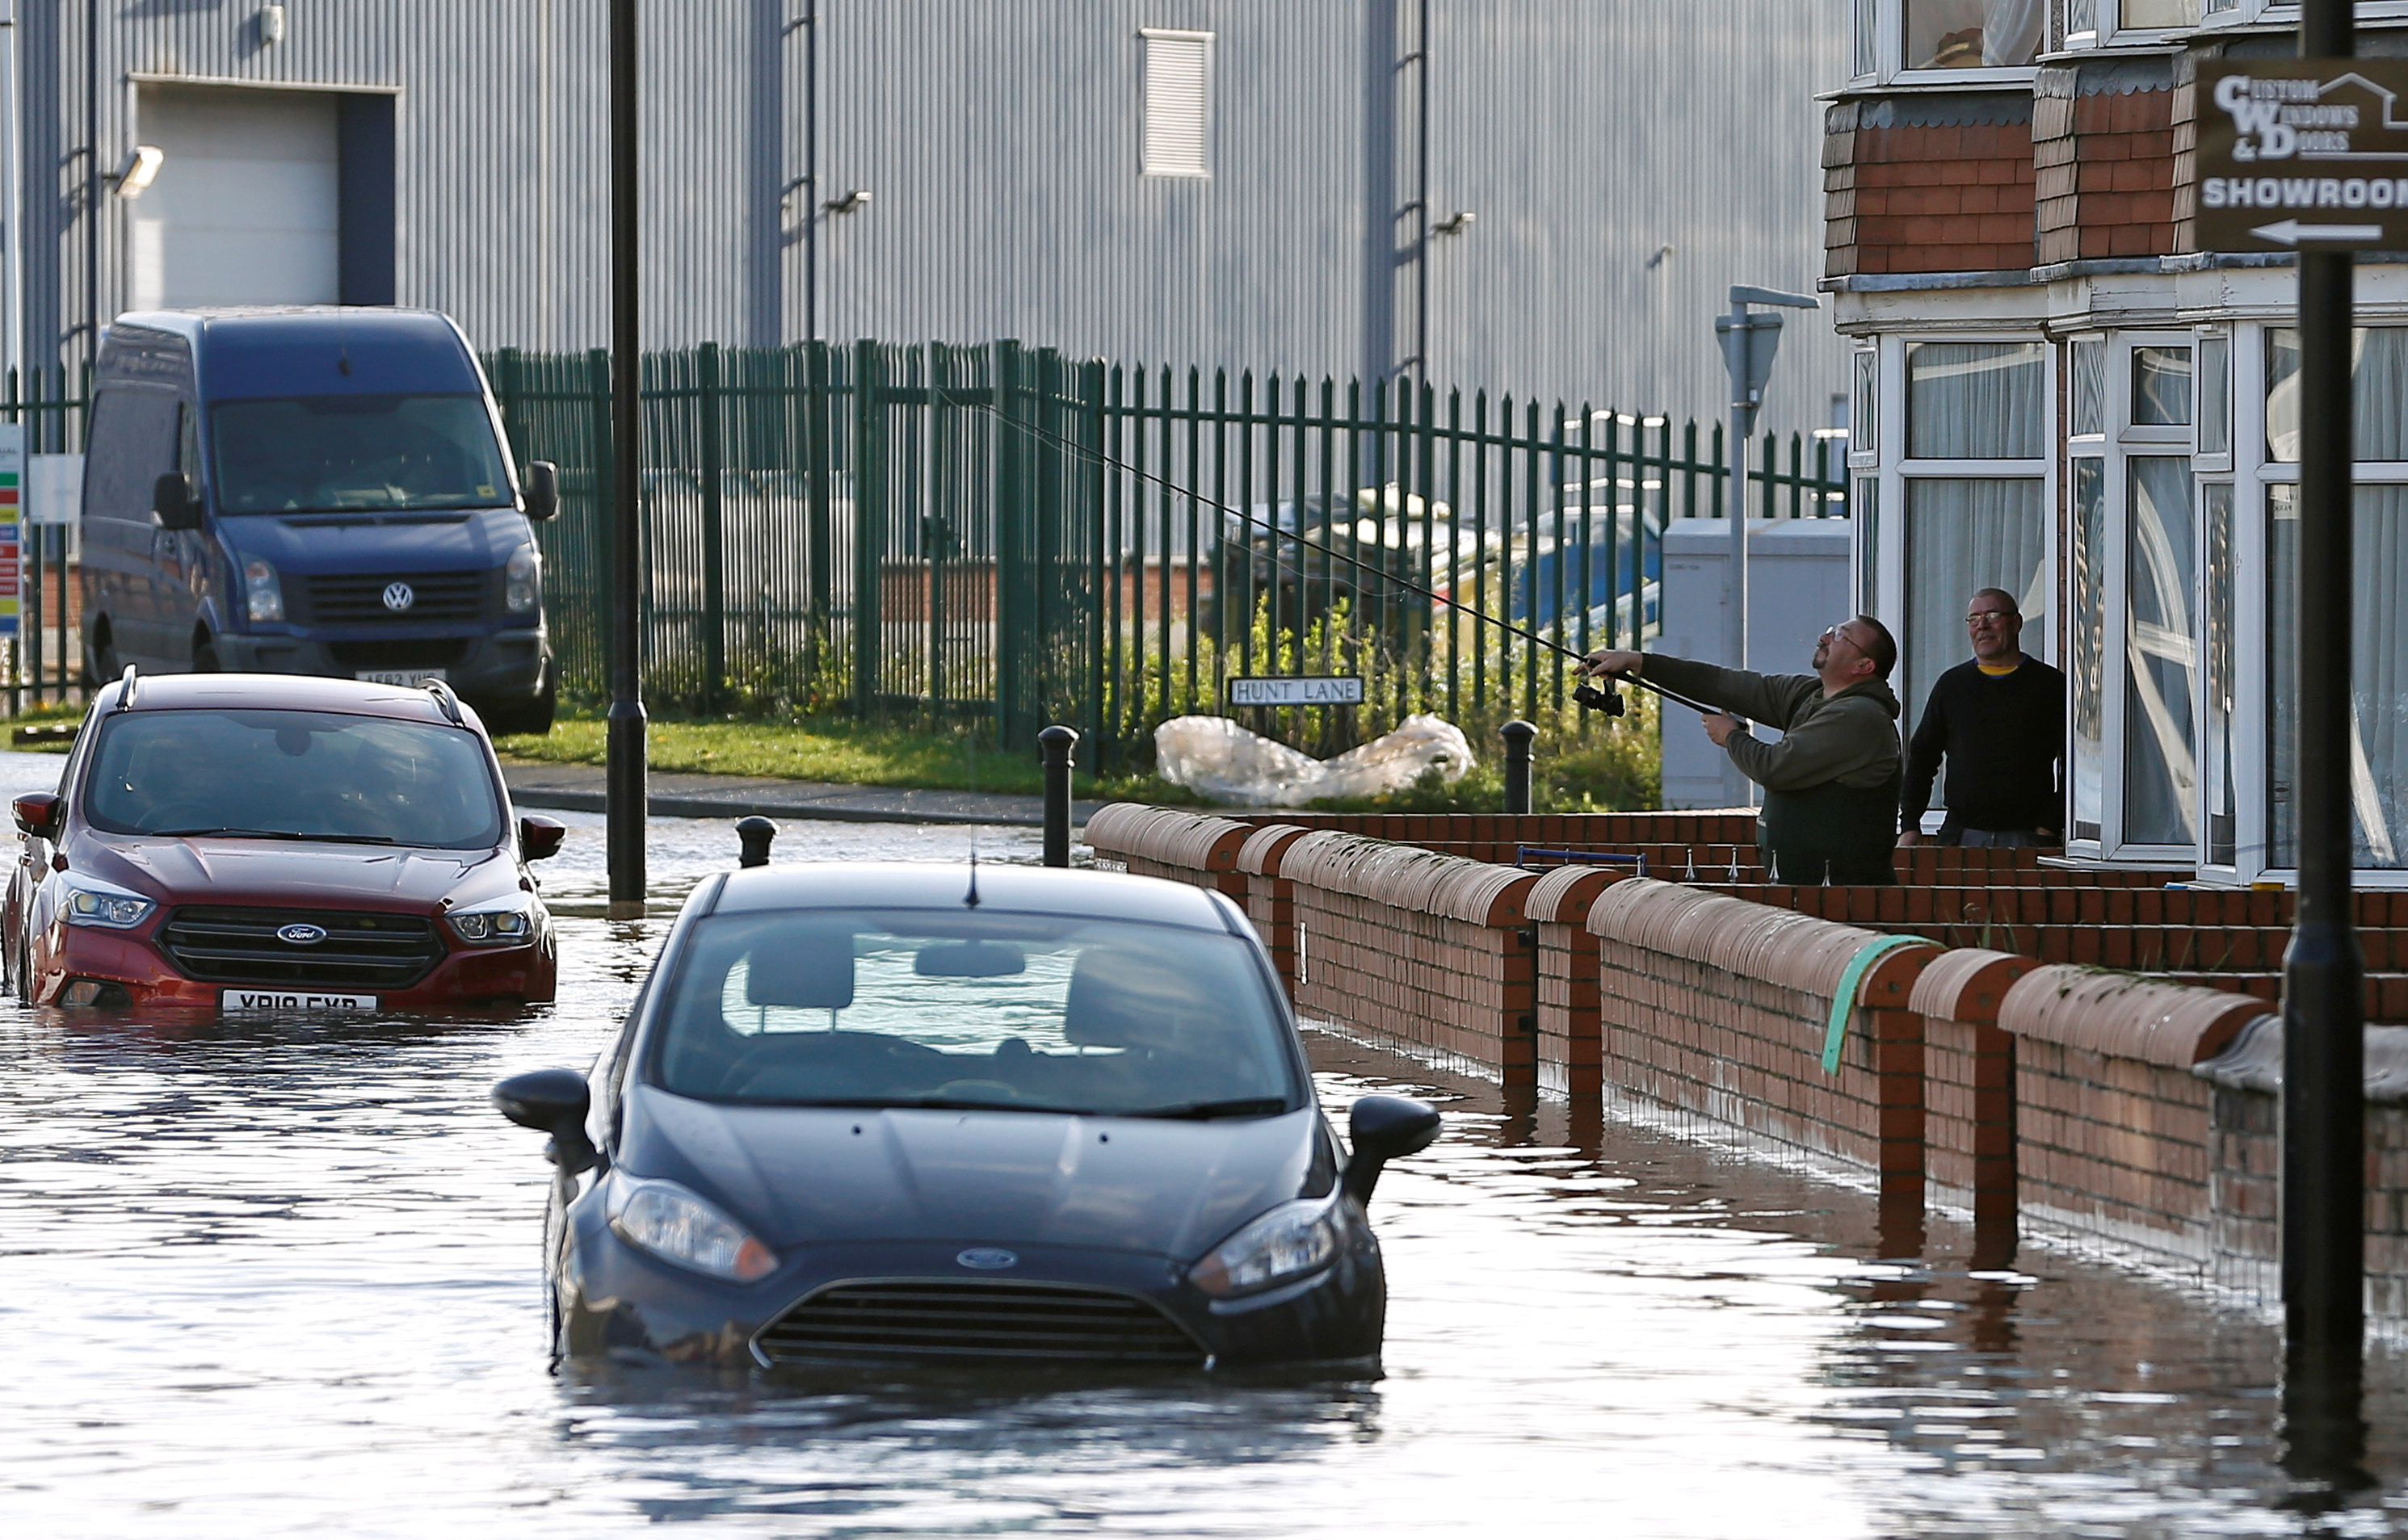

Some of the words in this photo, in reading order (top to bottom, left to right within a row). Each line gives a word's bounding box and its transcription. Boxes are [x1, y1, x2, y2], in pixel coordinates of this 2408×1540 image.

[2232, 137, 2257, 162] &
[1237, 682, 1291, 701] HUNT
[1304, 682, 1355, 699] LANE
[288, 928, 316, 938] Ford
